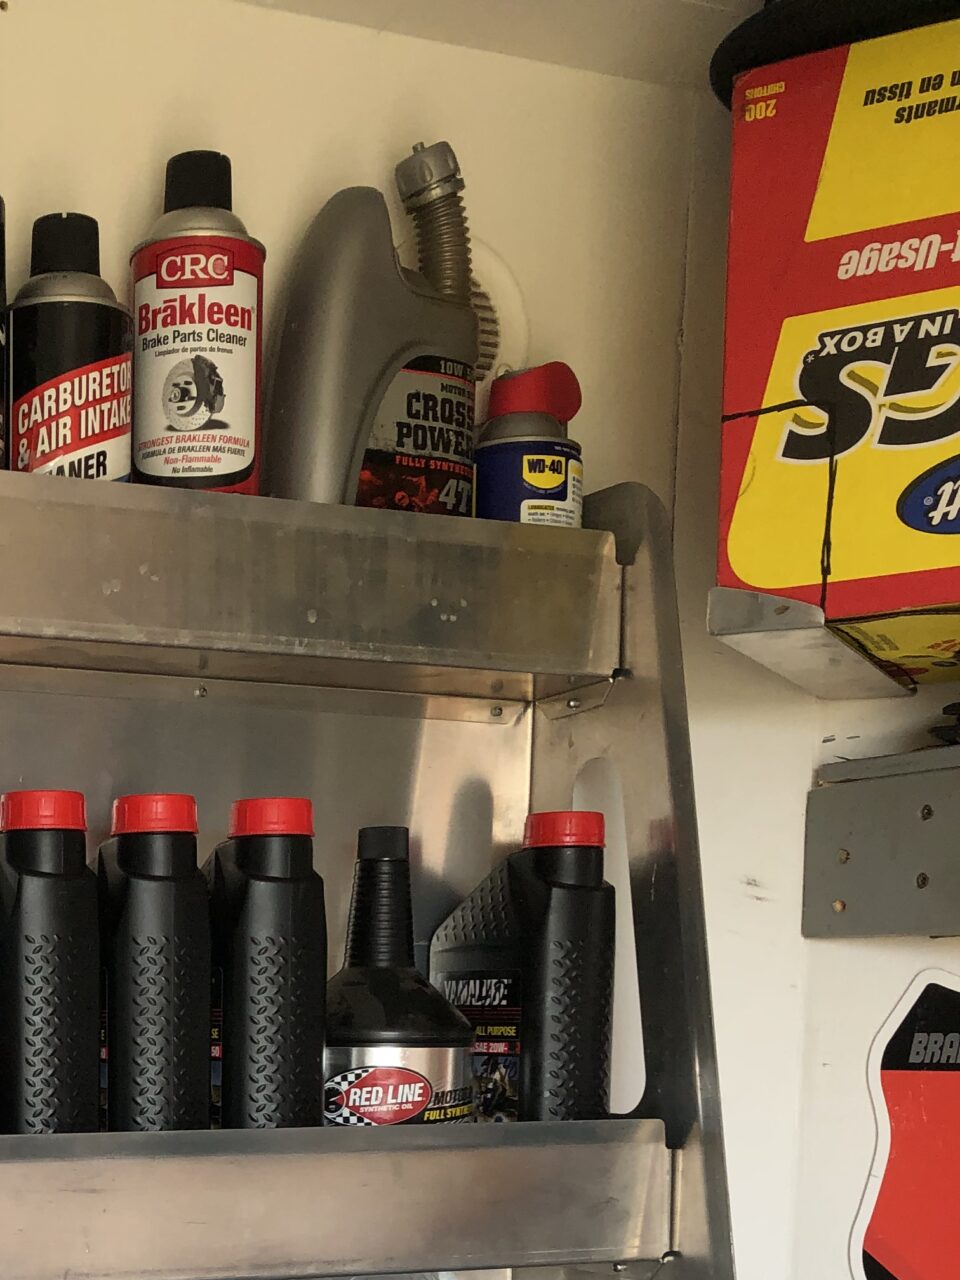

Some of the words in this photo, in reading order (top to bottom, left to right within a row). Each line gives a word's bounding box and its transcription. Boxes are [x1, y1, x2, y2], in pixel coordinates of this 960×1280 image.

[863, 80, 913, 107] tissu
[918, 73, 945, 93] en
[744, 99, 777, 122] 200
[160, 254, 229, 282] CRC
[142, 334, 169, 352] Brake
[172, 329, 203, 344] Parts
[207, 328, 248, 348] Cleaner
[893, 319, 915, 348] A
[917, 310, 954, 342] IN
[820, 325, 884, 358] BOX
[17, 360, 132, 435] CARBURETOR
[406, 390, 475, 432] CROSS
[17, 438, 30, 469] &
[36, 415, 72, 459] AIR
[80, 395, 132, 439] INTAKE
[175, 434, 218, 444] BRAKLEEN
[218, 435, 250, 449] FORMULA
[396, 421, 475, 460] POWER
[47, 449, 108, 480] ANER
[395, 455, 425, 469] FULLY
[527, 458, 564, 477] WD-40
[487, 1026, 516, 1037] PURPOSE
[349, 1087, 383, 1107] RED
[387, 1082, 425, 1104] LINE
[359, 1103, 401, 1113] SYNTHETIC
[401, 1102, 414, 1111] OIL
[424, 1110, 445, 1121] FULL
